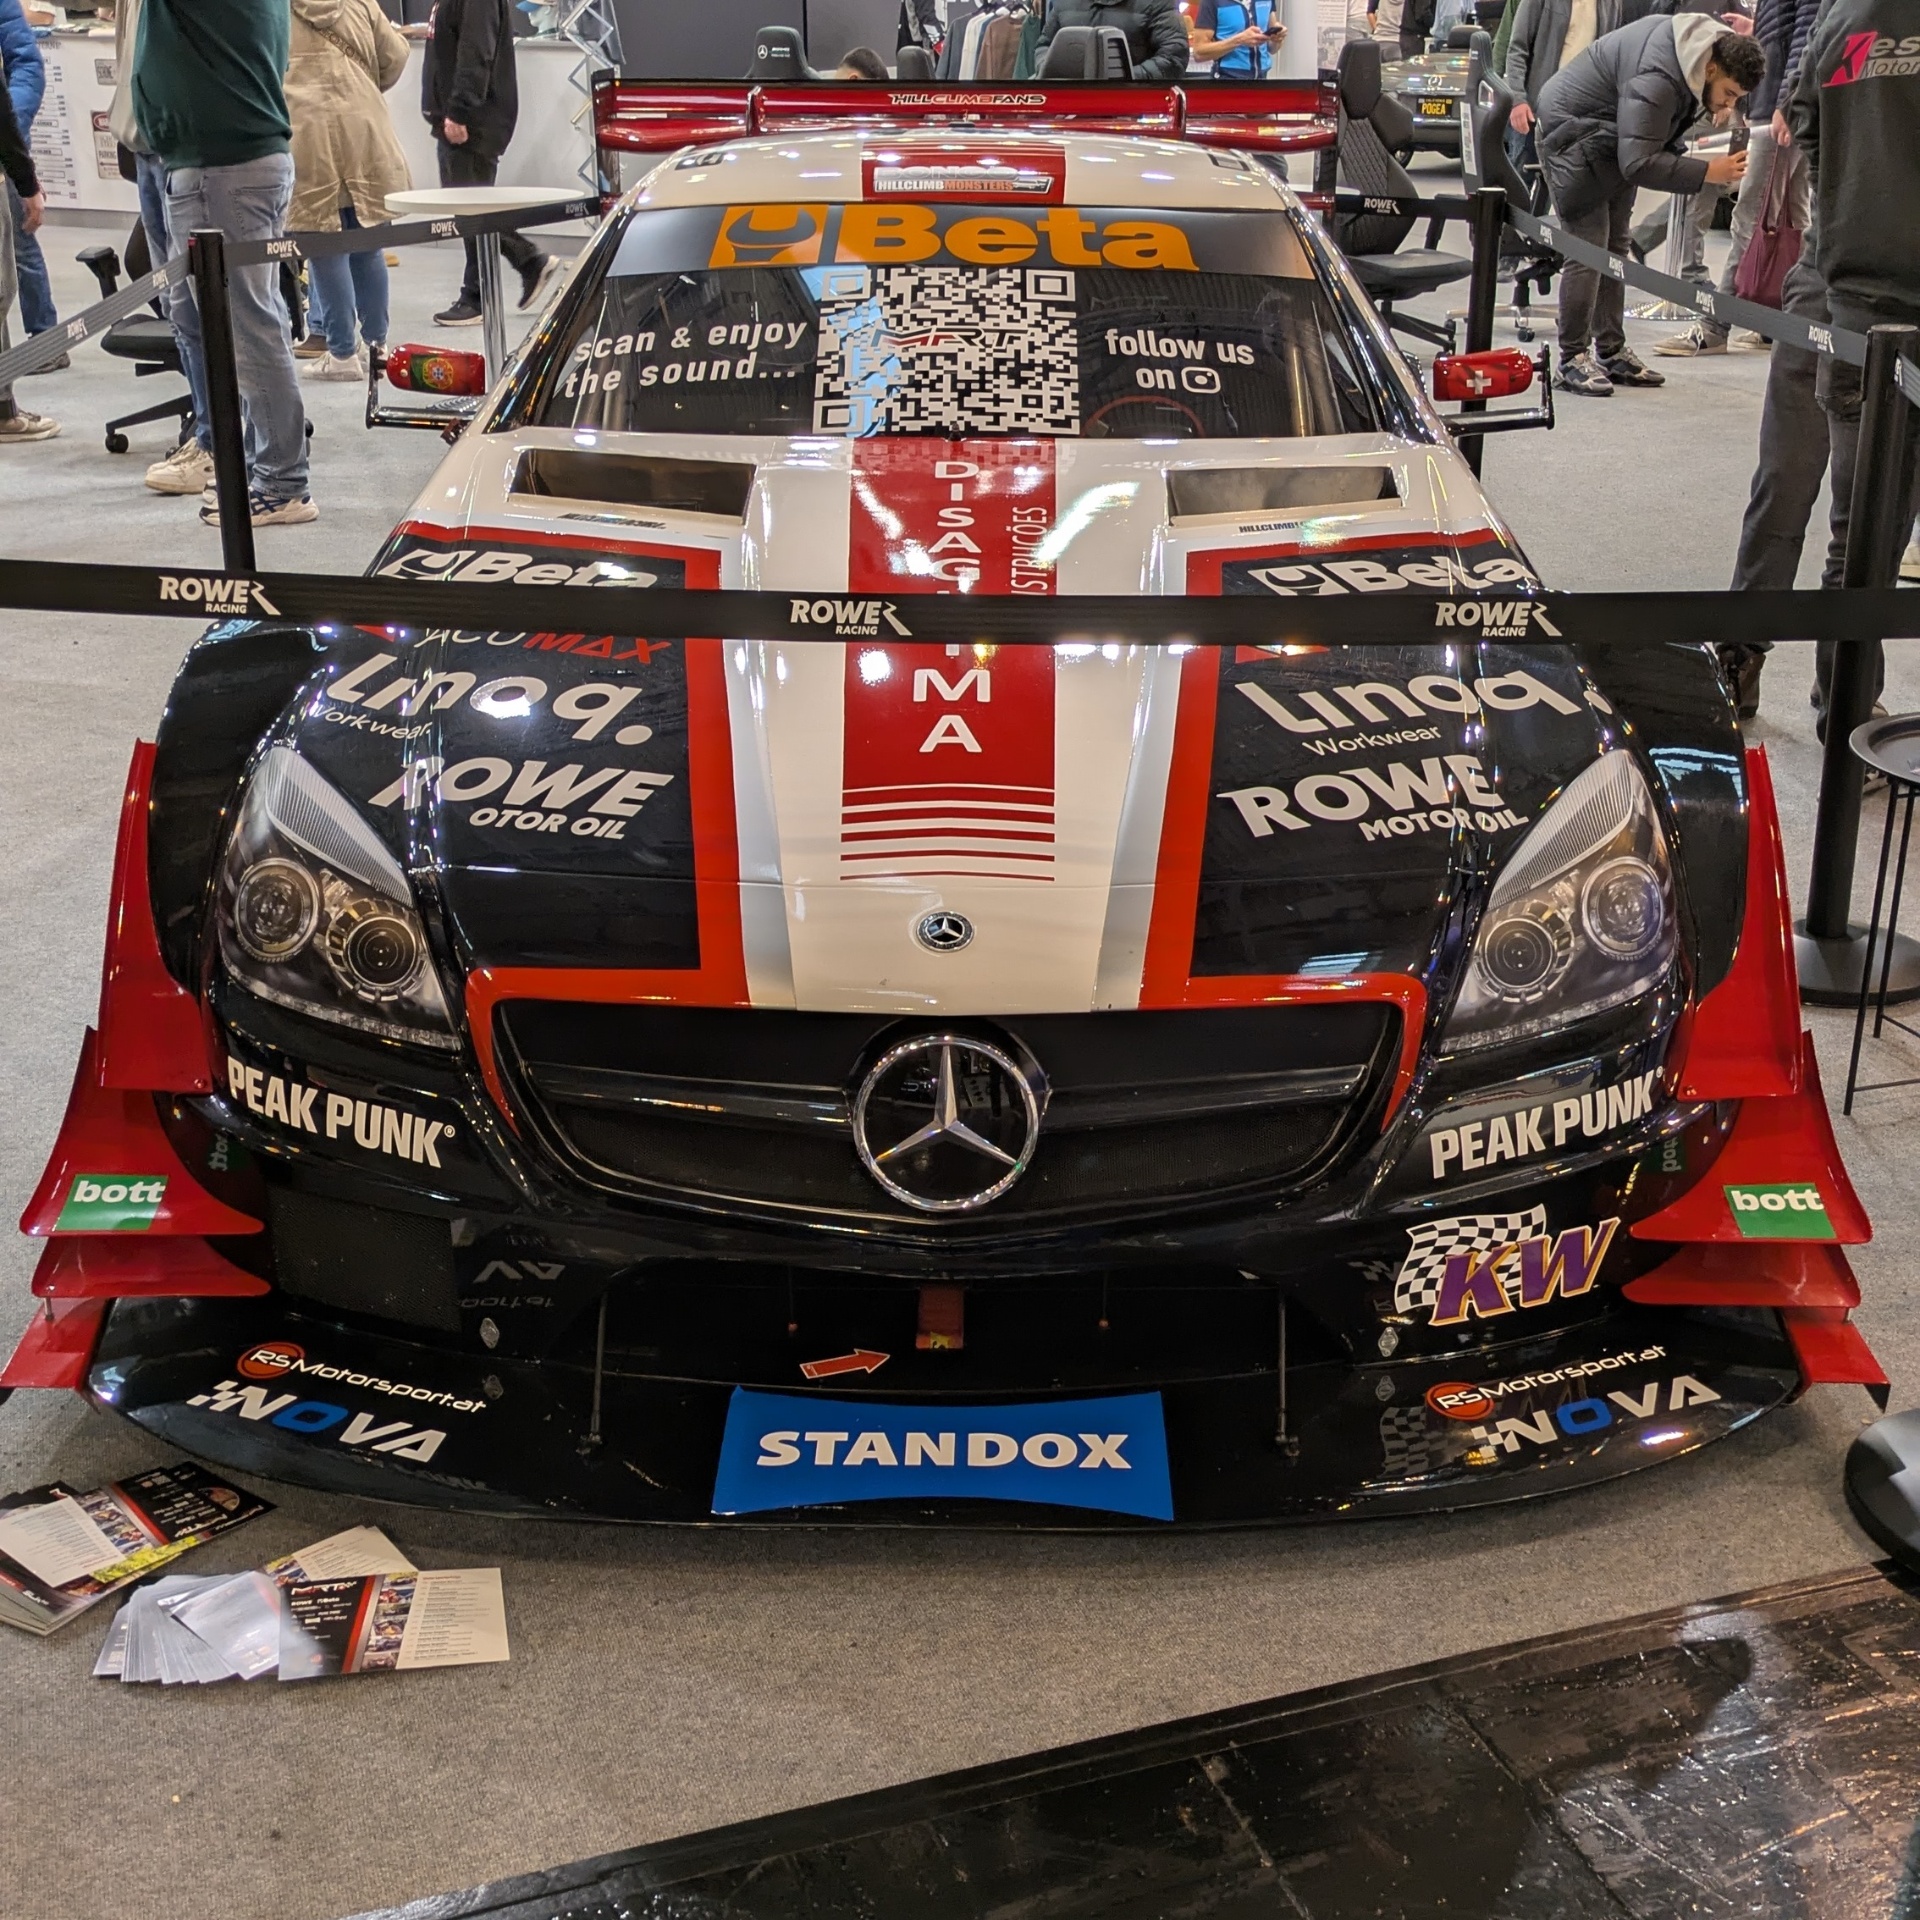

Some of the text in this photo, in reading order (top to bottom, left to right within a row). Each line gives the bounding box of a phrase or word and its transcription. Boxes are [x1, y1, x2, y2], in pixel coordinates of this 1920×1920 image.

[834, 205, 1199, 271] Beta
[573, 321, 807, 363] scan & enjoy
[1105, 328, 1255, 365] follow us
[564, 351, 796, 398] the sound...
[1136, 367, 1177, 389] on
[158, 576, 250, 603] ROWE
[1322, 555, 1539, 593] Beta
[205, 602, 248, 614] RACING
[789, 599, 883, 625] ROWE
[1435, 601, 1532, 627] ROWE
[835, 625, 878, 636] RACING
[1481, 626, 1527, 637] RACING
[1302, 724, 1442, 757] Workwear
[368, 756, 675, 818] ROWE
[1216, 754, 1505, 838] ROWE
[570, 815, 627, 841] OIL
[1358, 808, 1530, 842] MOTOR OIL
[227, 1055, 319, 1135] PEAK
[1430, 1105, 1546, 1179] PEAK
[73, 1179, 166, 1204] bott
[1730, 1189, 1824, 1212] bott
[1428, 1217, 1621, 1326] KW
[212, 1382, 447, 1464] NOVA
[1488, 1375, 1722, 1453] NOVA
[757, 1431, 1132, 1469] STANDOX
